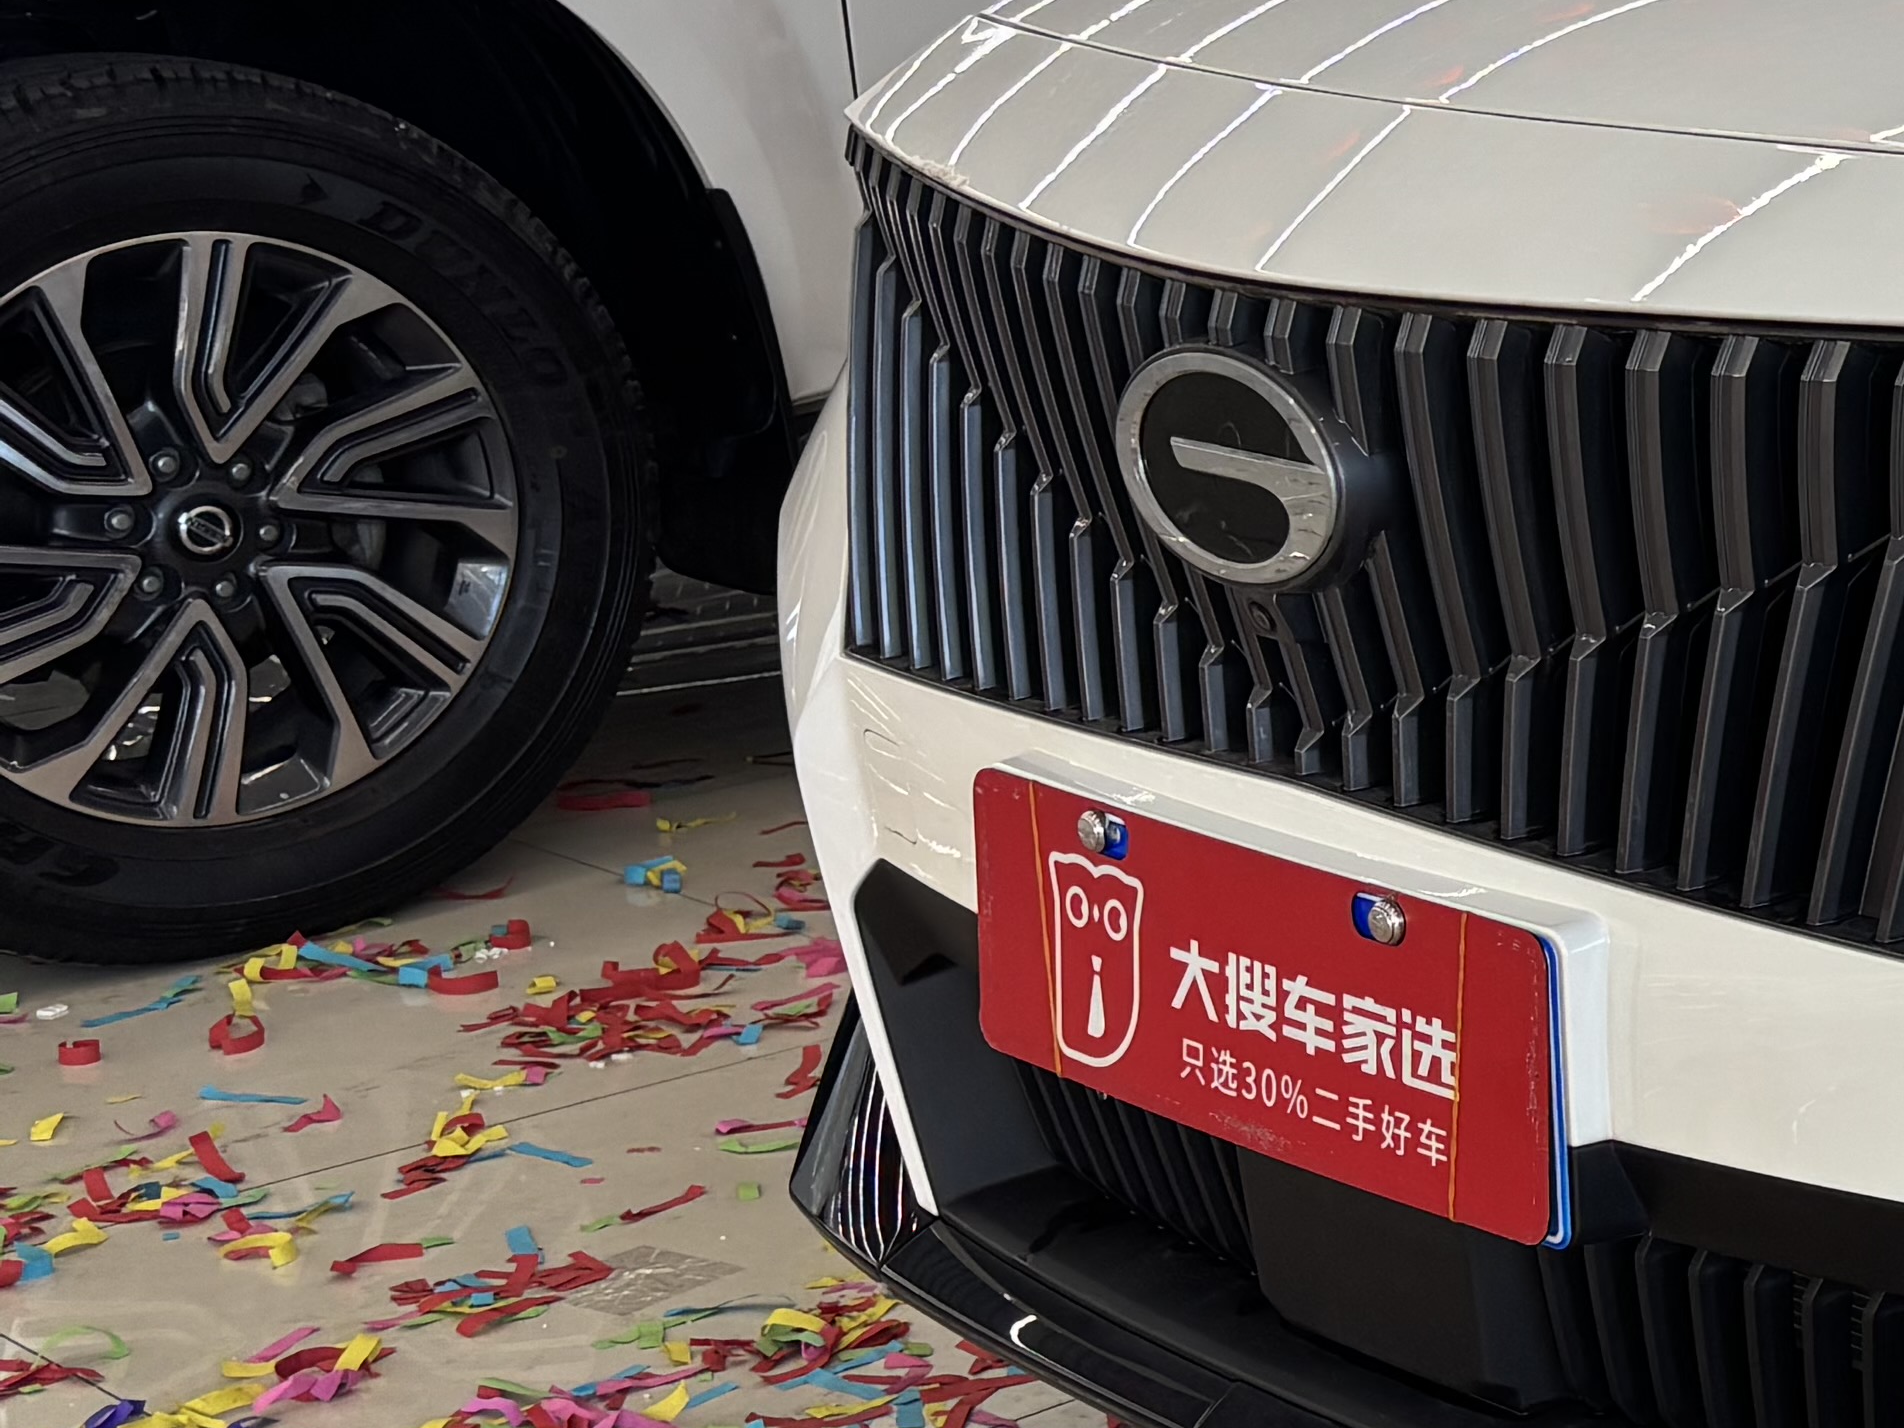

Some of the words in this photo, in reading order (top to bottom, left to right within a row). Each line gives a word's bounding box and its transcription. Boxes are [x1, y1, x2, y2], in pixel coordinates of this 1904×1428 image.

[1169, 939, 1459, 1102] 大搜车家选
[1180, 1038, 1448, 1166] 只选30%二手好车
